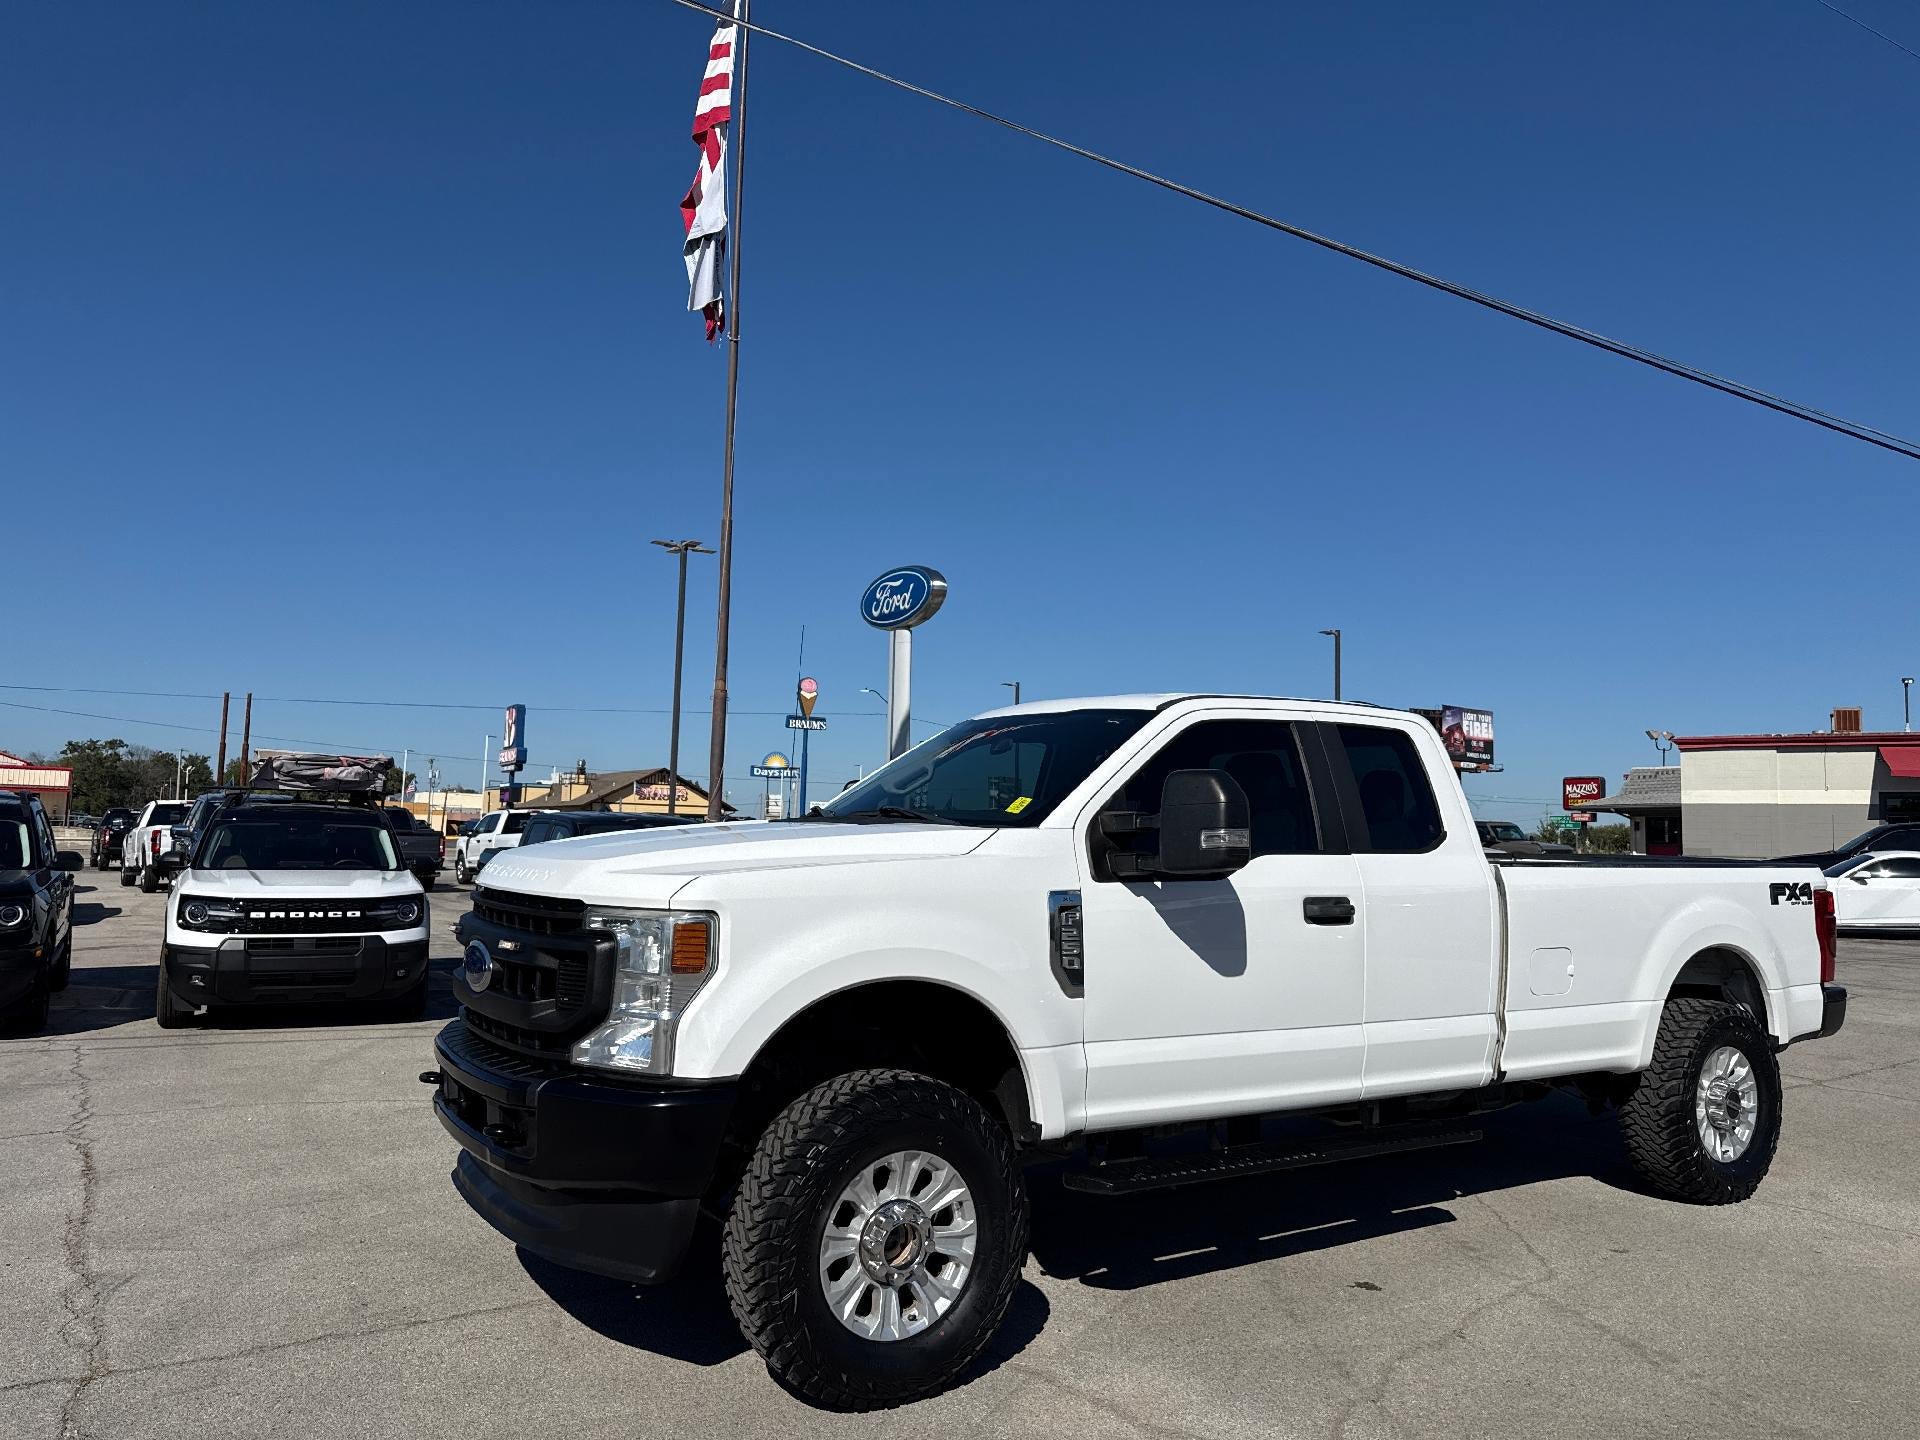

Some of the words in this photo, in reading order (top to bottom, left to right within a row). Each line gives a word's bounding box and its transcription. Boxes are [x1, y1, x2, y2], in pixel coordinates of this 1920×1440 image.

[872, 578, 914, 617] Ford
[753, 767, 780, 777] Days
[1769, 882, 1813, 905] FX4
